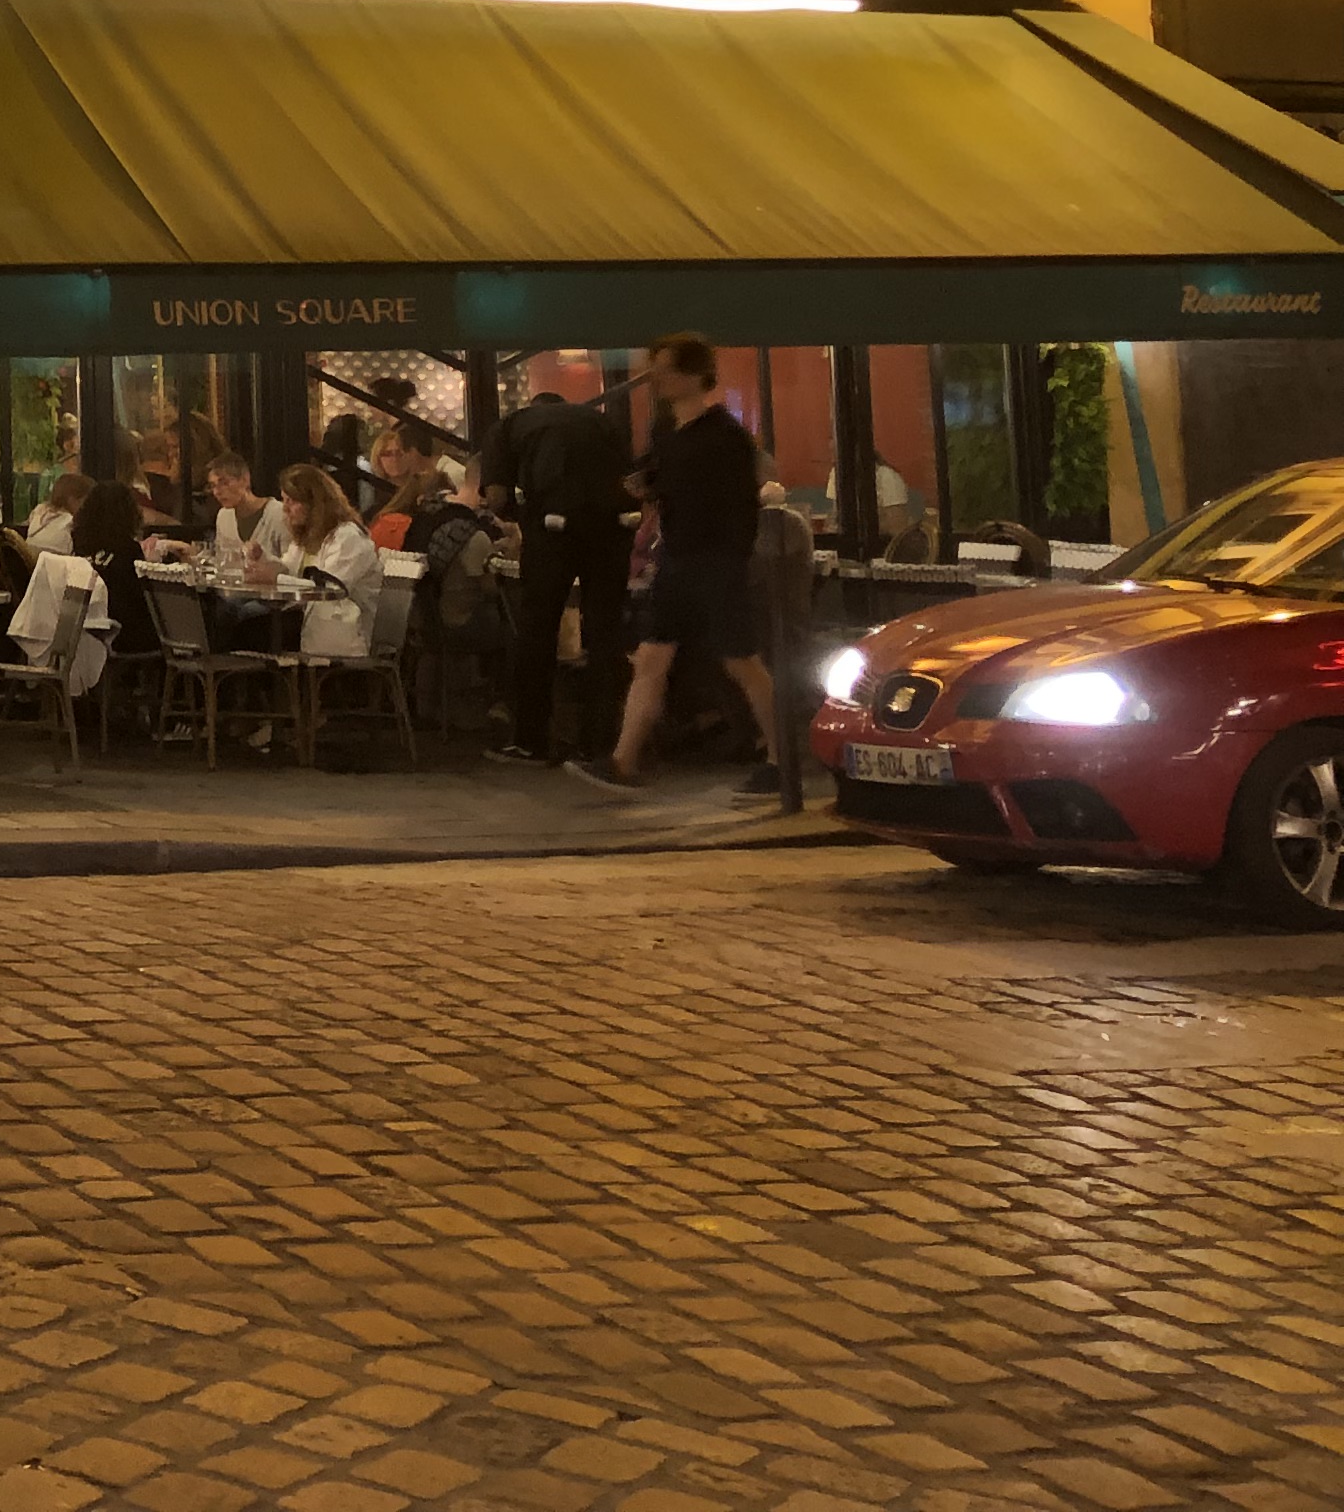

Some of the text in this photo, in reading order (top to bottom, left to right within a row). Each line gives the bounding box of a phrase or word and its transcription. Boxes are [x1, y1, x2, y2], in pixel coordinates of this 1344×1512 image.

[153, 297, 417, 327] UNION SQUARE
[1180, 284, 1322, 315] Restaurant
